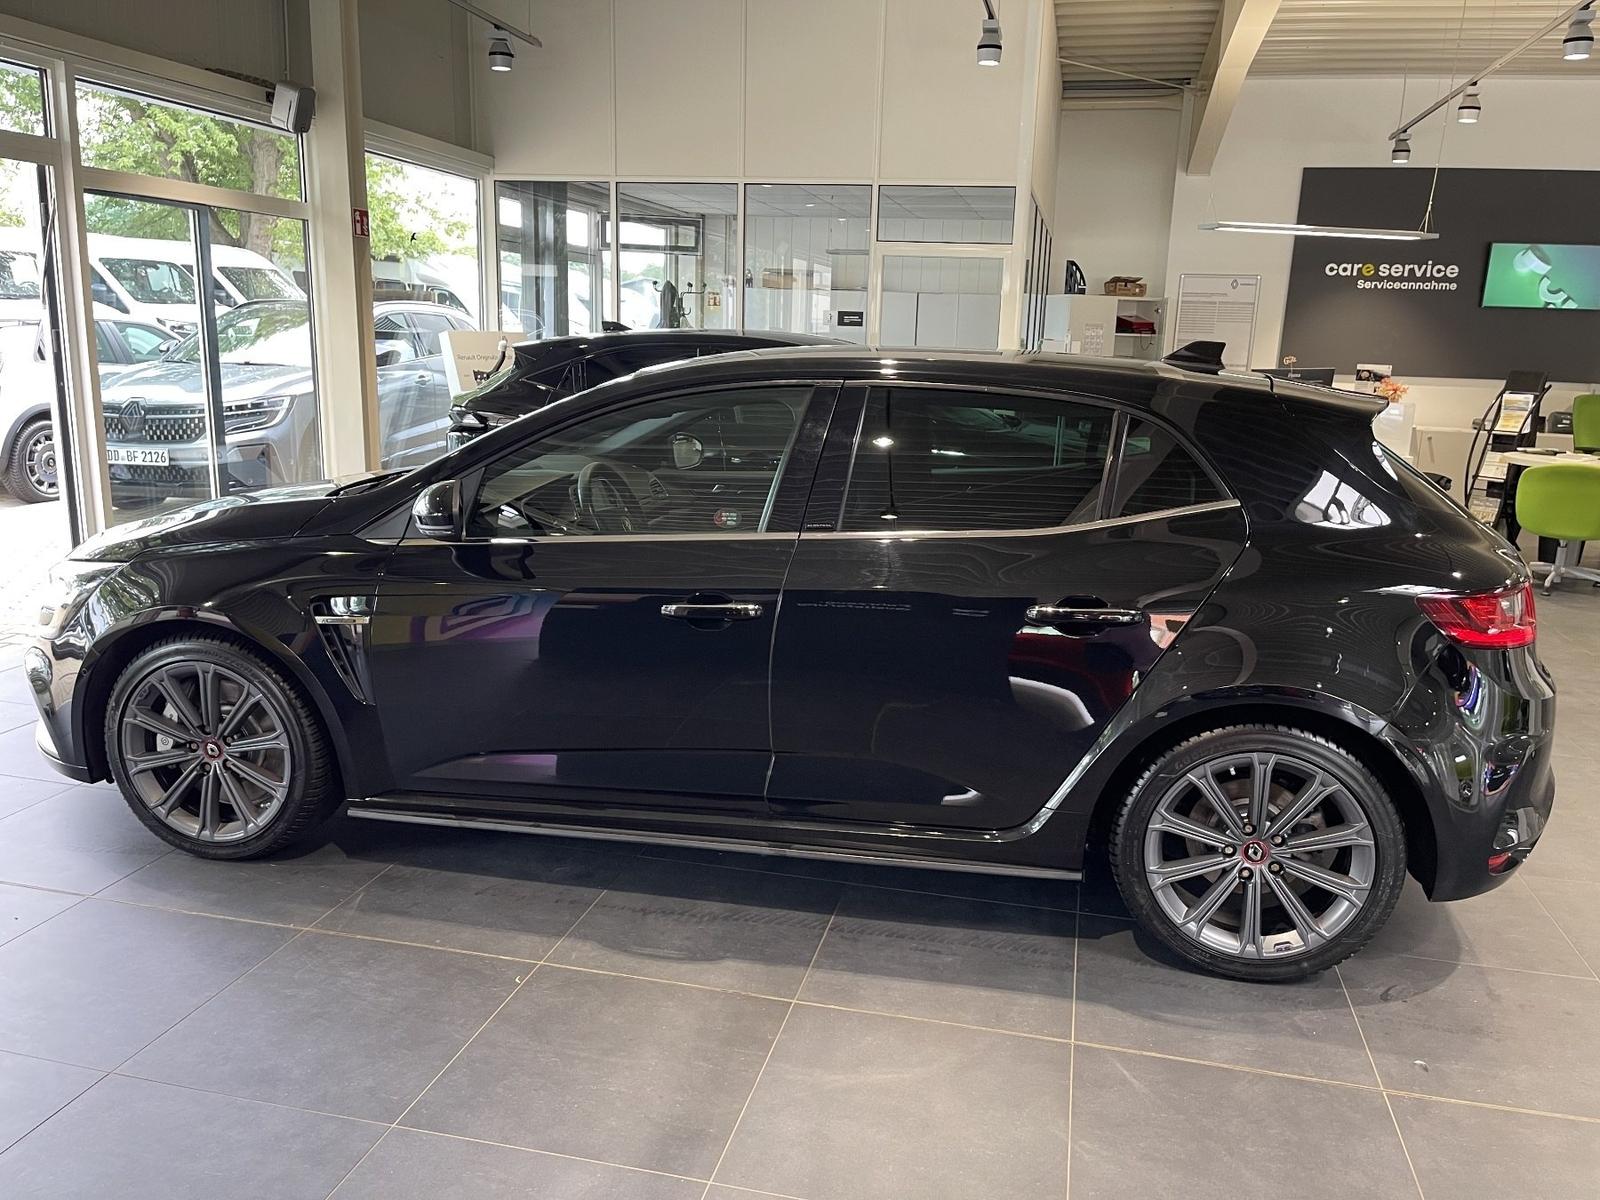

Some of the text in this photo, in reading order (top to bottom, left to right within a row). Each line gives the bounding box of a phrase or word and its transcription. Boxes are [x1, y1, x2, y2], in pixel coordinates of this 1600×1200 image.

[1325, 260, 1459, 278] care service
[1356, 279, 1458, 291] Serviceannahme
[106, 449, 167, 463] DD BF 2126
